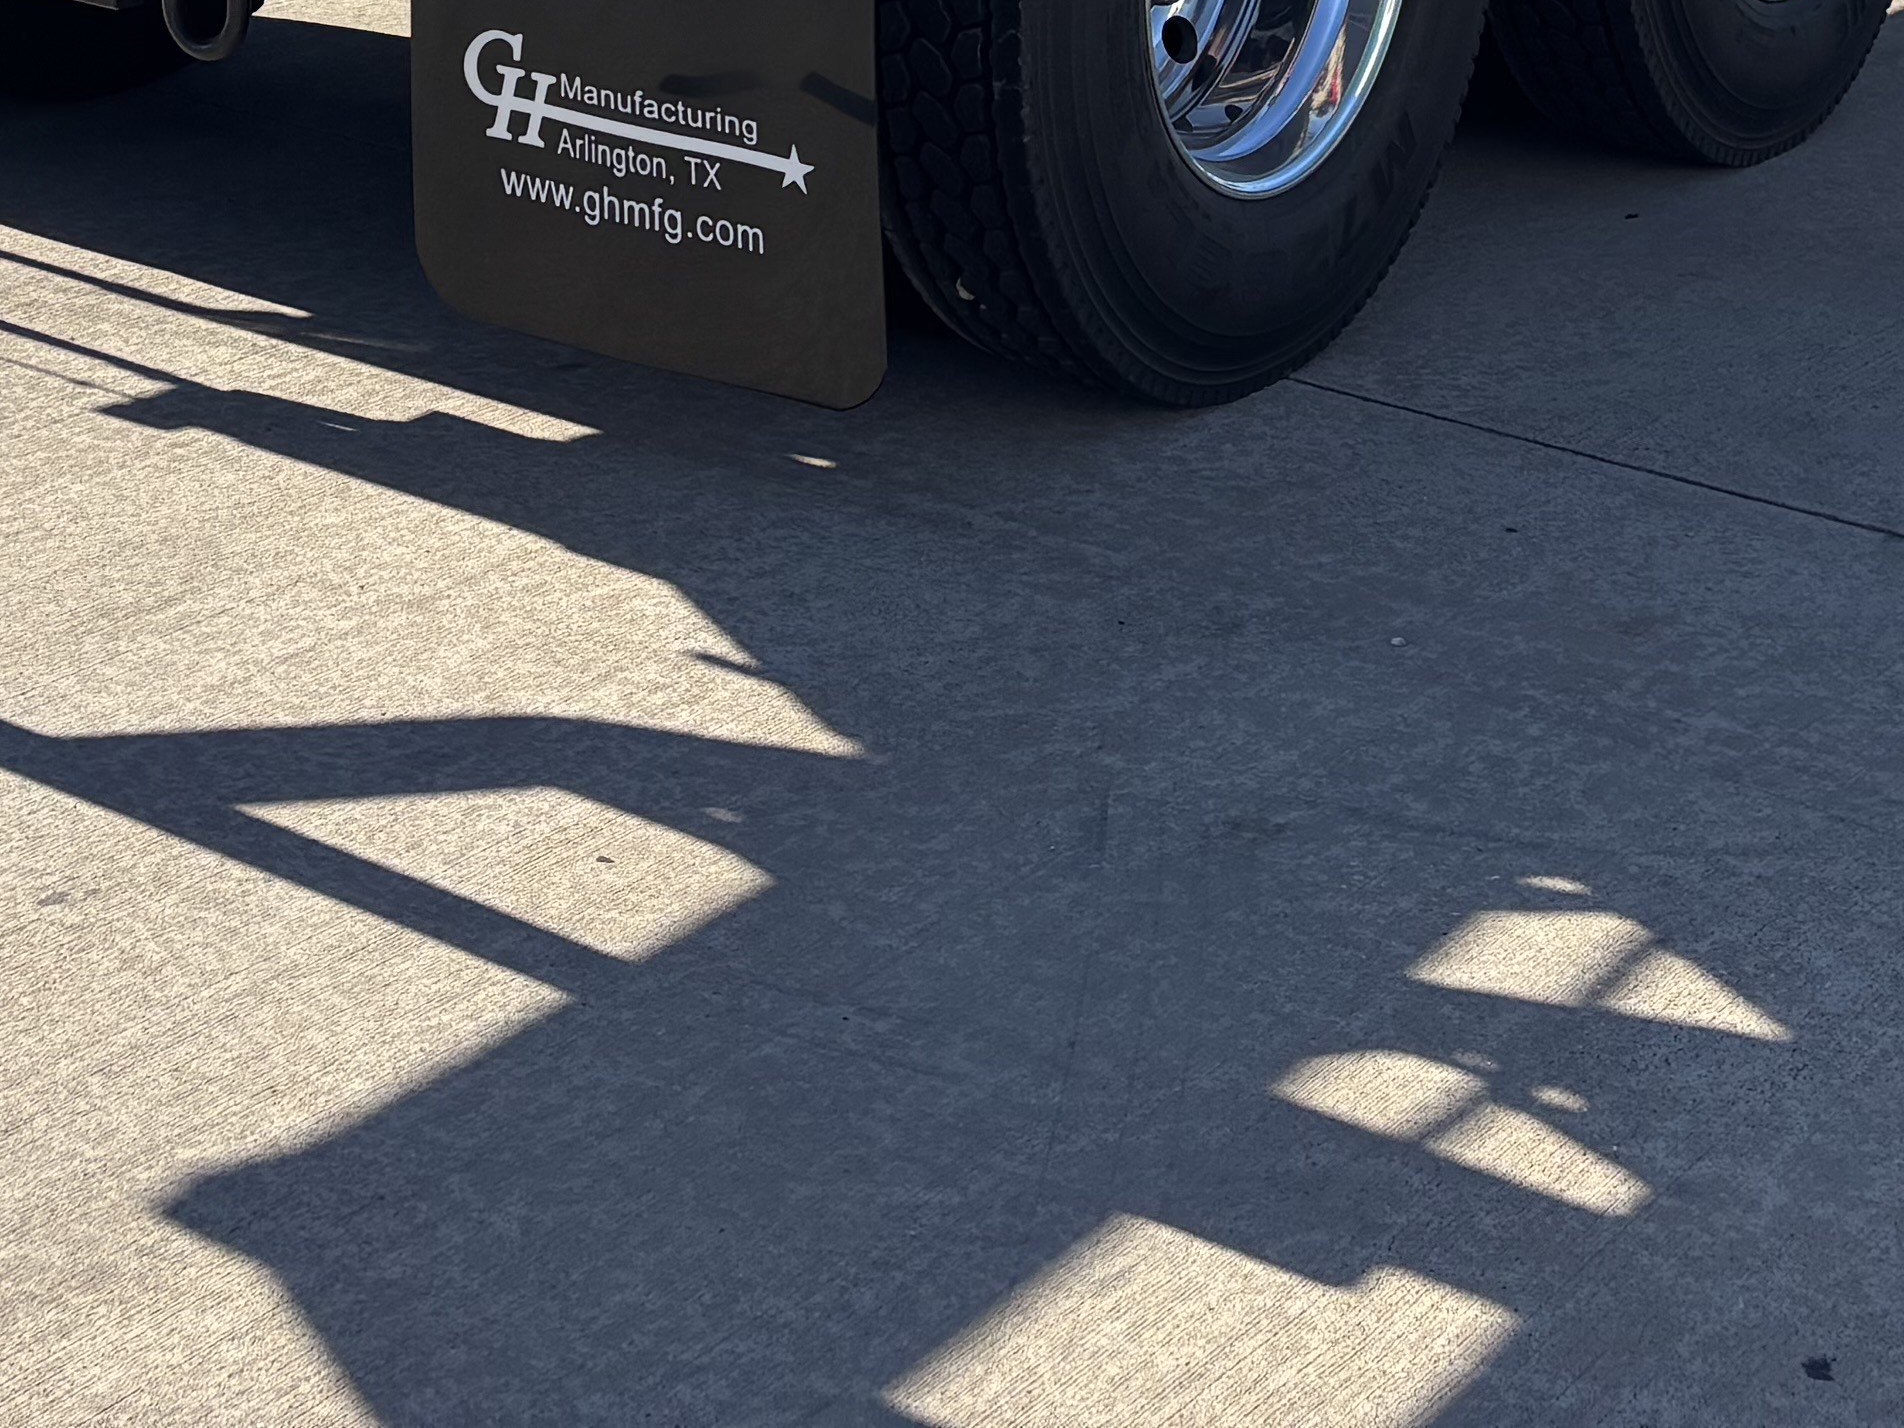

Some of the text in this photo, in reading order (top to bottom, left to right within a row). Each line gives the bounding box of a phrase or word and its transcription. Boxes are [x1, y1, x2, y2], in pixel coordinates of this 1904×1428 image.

[463, 29, 758, 147] GH Manufacturing
[557, 128, 723, 191] Arlington, TX
[500, 167, 765, 255] www.ghmfg.com
